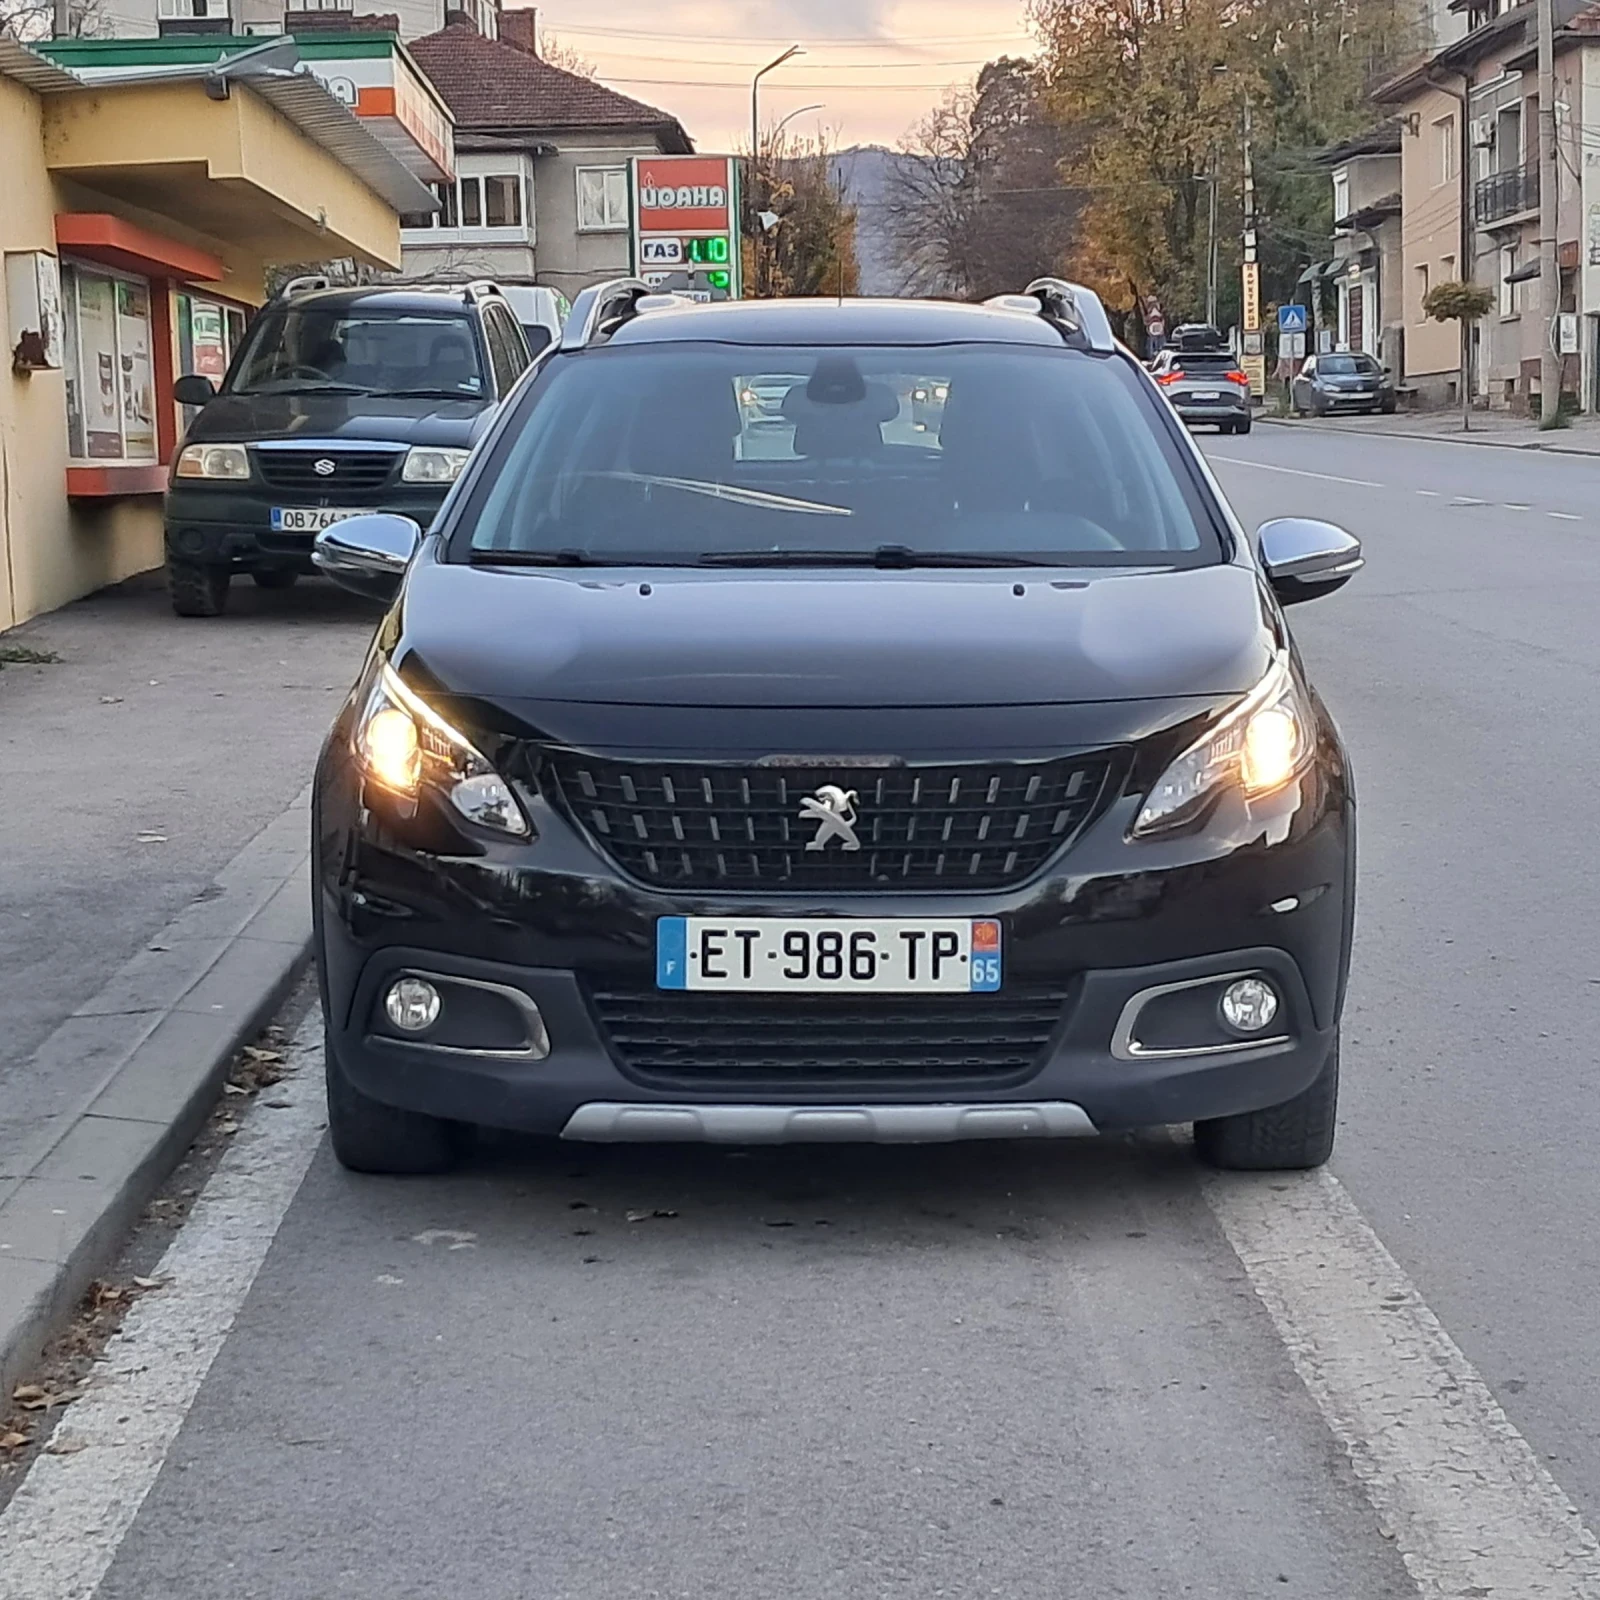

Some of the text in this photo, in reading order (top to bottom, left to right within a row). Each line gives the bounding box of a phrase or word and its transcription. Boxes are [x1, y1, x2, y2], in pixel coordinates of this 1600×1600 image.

[643, 243, 680, 258] ГАЗ
[666, 960, 676, 976] F
[972, 959, 999, 983] 65
